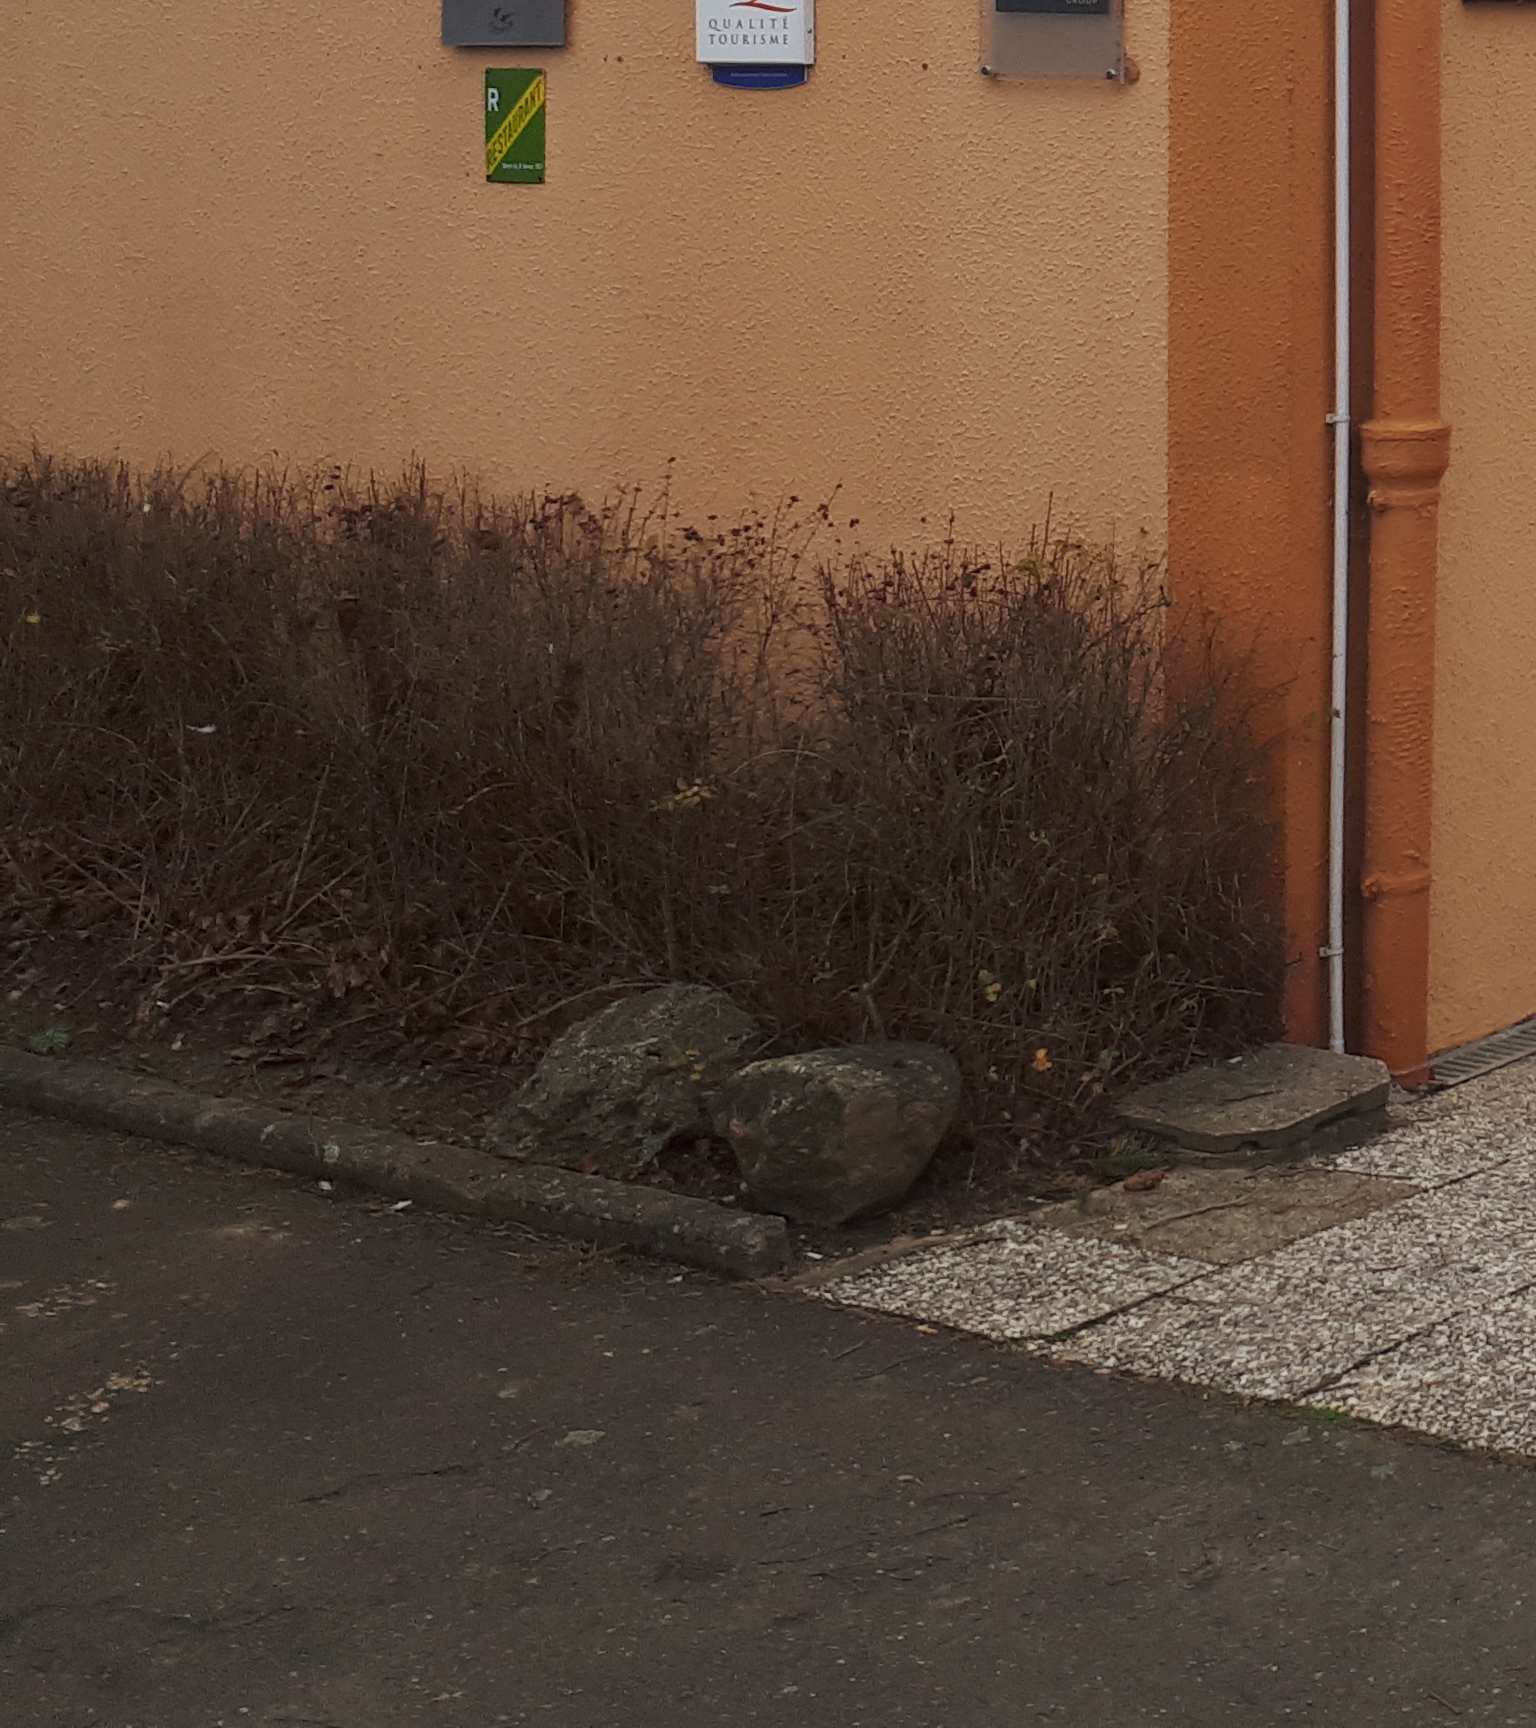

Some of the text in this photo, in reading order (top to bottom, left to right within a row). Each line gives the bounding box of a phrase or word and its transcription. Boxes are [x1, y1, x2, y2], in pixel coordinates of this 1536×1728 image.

[708, 15, 789, 32] QUALITÉ
[708, 34, 789, 45] TOURISME
[487, 87, 500, 112] R
